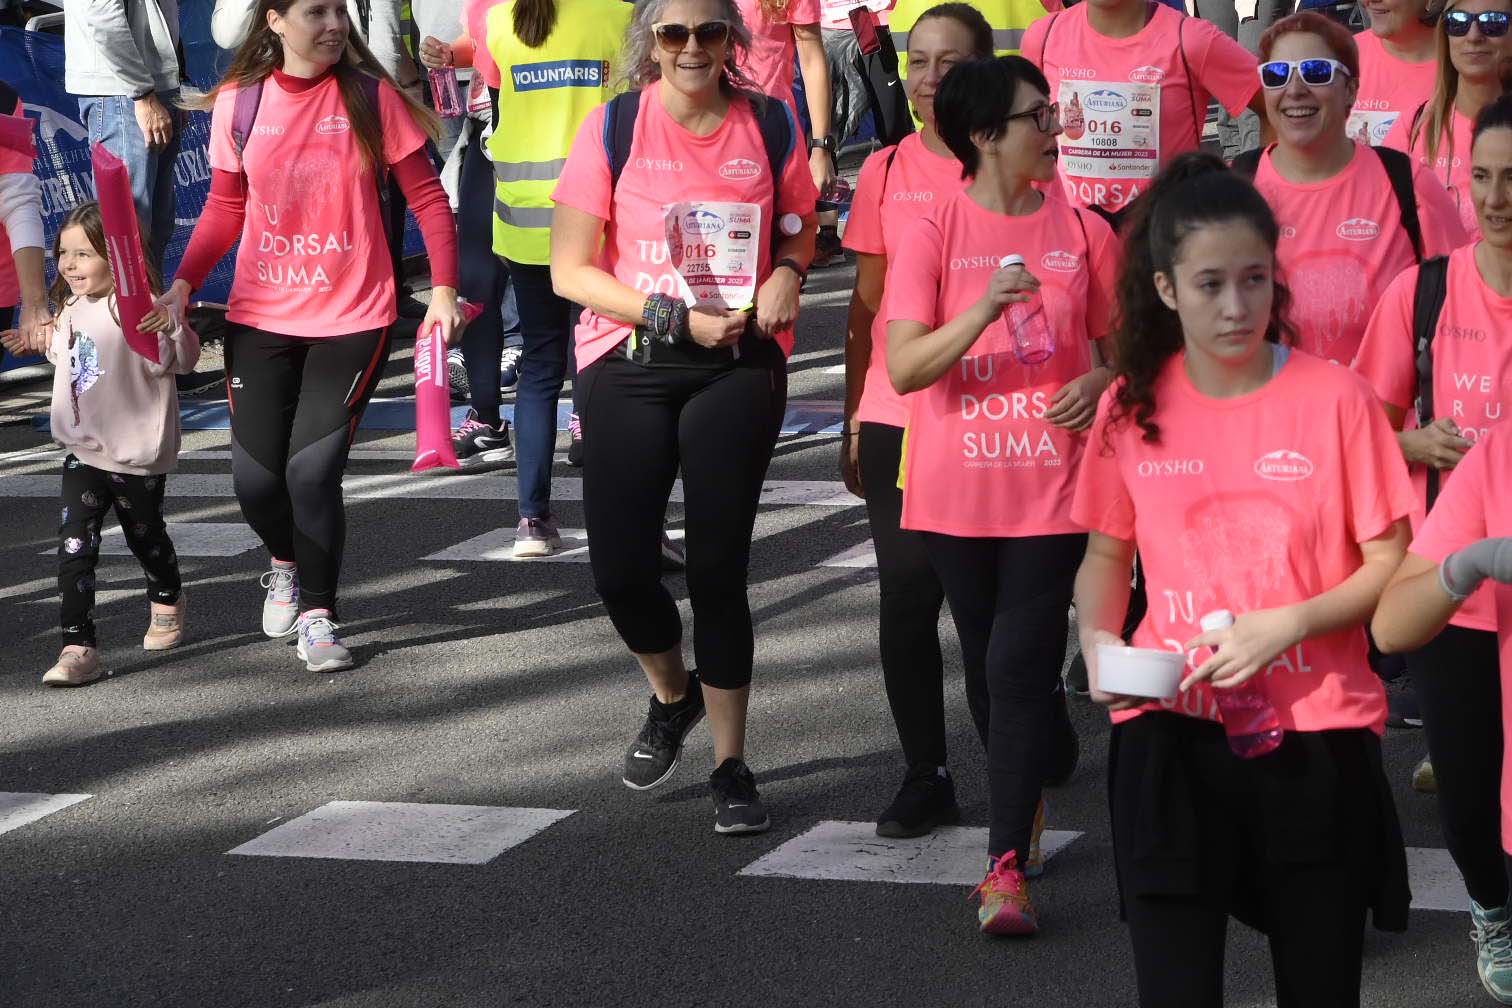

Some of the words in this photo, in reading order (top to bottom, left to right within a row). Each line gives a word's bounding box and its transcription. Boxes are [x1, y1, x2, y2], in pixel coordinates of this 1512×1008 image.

[512, 66, 599, 86] VOLUNTARIS
[1088, 120, 1122, 134] 016
[1091, 137, 1118, 147] 10808
[636, 158, 683, 171] OYSHO
[259, 230, 353, 257] DORSAL
[686, 243, 716, 258] 016
[950, 255, 1002, 271] OYSHO
[257, 261, 331, 285] SUMA
[961, 356, 993, 382] TU
[1454, 373, 1491, 392] WE
[963, 432, 1057, 459] SUMA
[1138, 459, 1204, 477] OYSHO
